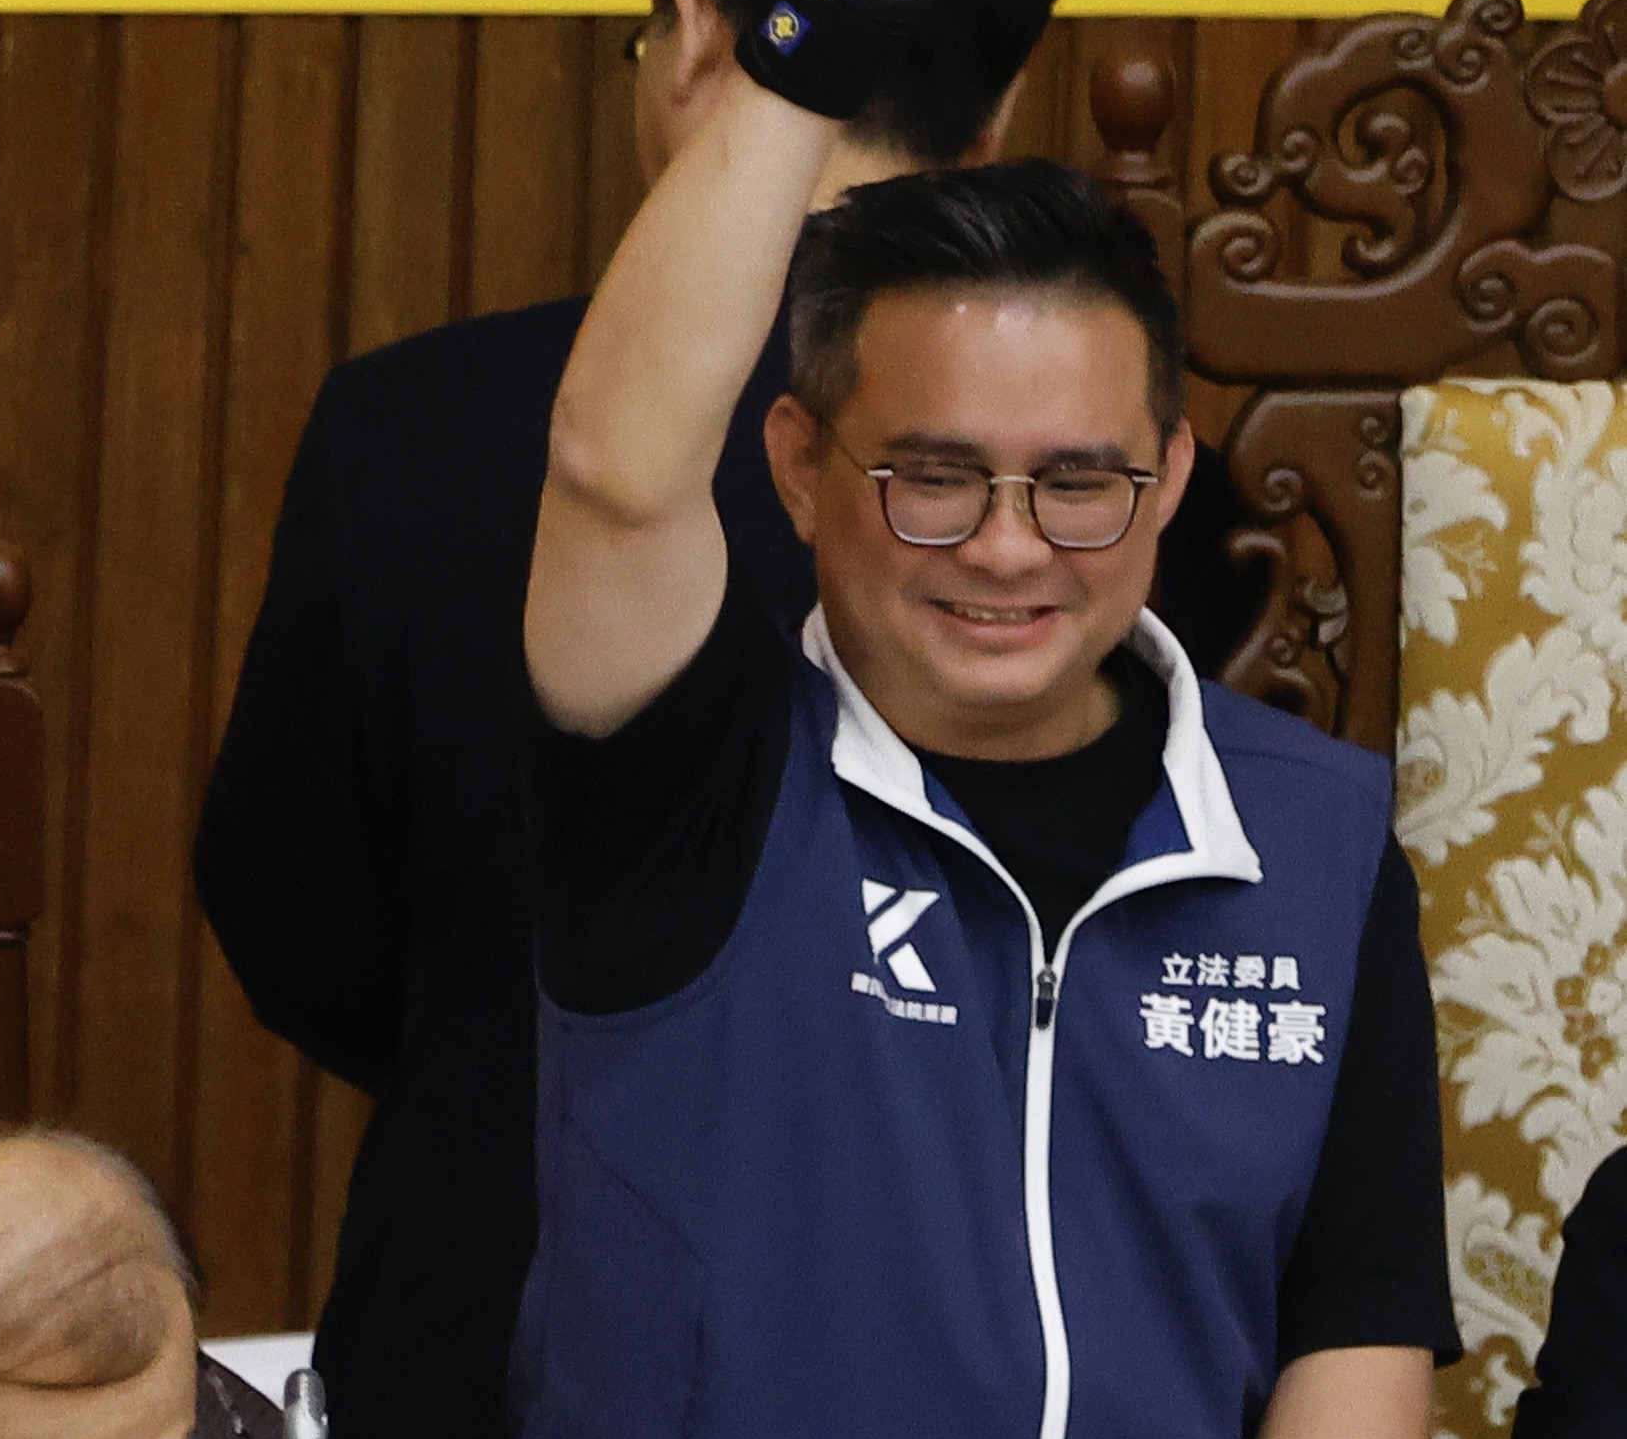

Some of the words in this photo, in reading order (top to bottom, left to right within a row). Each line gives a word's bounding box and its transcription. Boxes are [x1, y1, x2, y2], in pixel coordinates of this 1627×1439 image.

[1161, 952, 1301, 991] 立法委員
[1139, 993, 1326, 1064] 黃健豪
